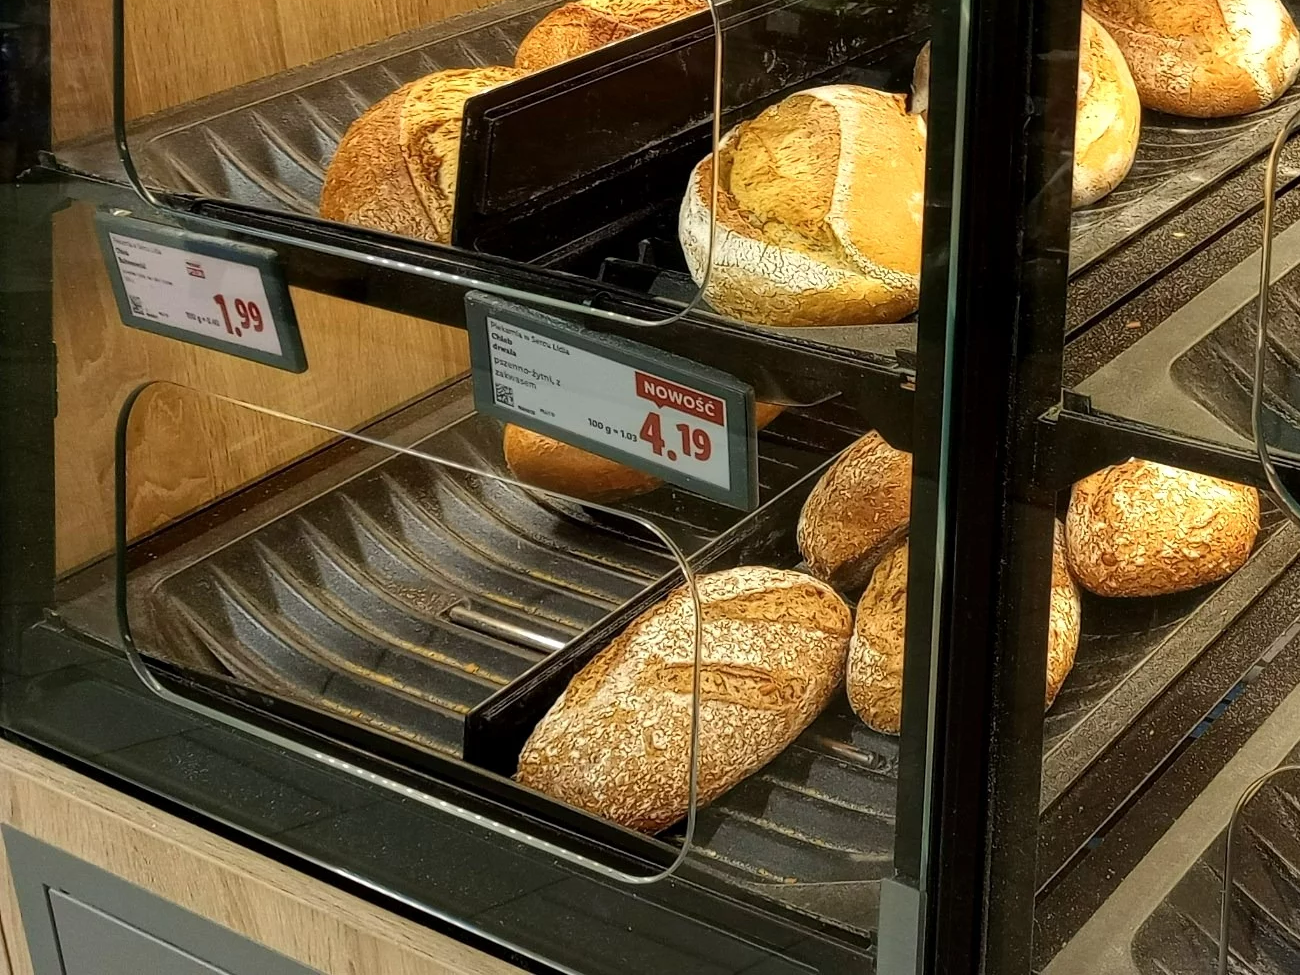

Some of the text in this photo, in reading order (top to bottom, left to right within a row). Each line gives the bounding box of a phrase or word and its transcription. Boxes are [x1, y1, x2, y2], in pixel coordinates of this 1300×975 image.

[213, 294, 264, 337] 1.99
[491, 332, 513, 346] Chleb
[495, 370, 537, 390] zakwasem
[643, 380, 716, 417] NOWOŚĆ
[587, 418, 604, 430] 100
[605, 426, 612, 435] g
[620, 430, 638, 442] 1.03
[640, 411, 712, 461] 4.19
